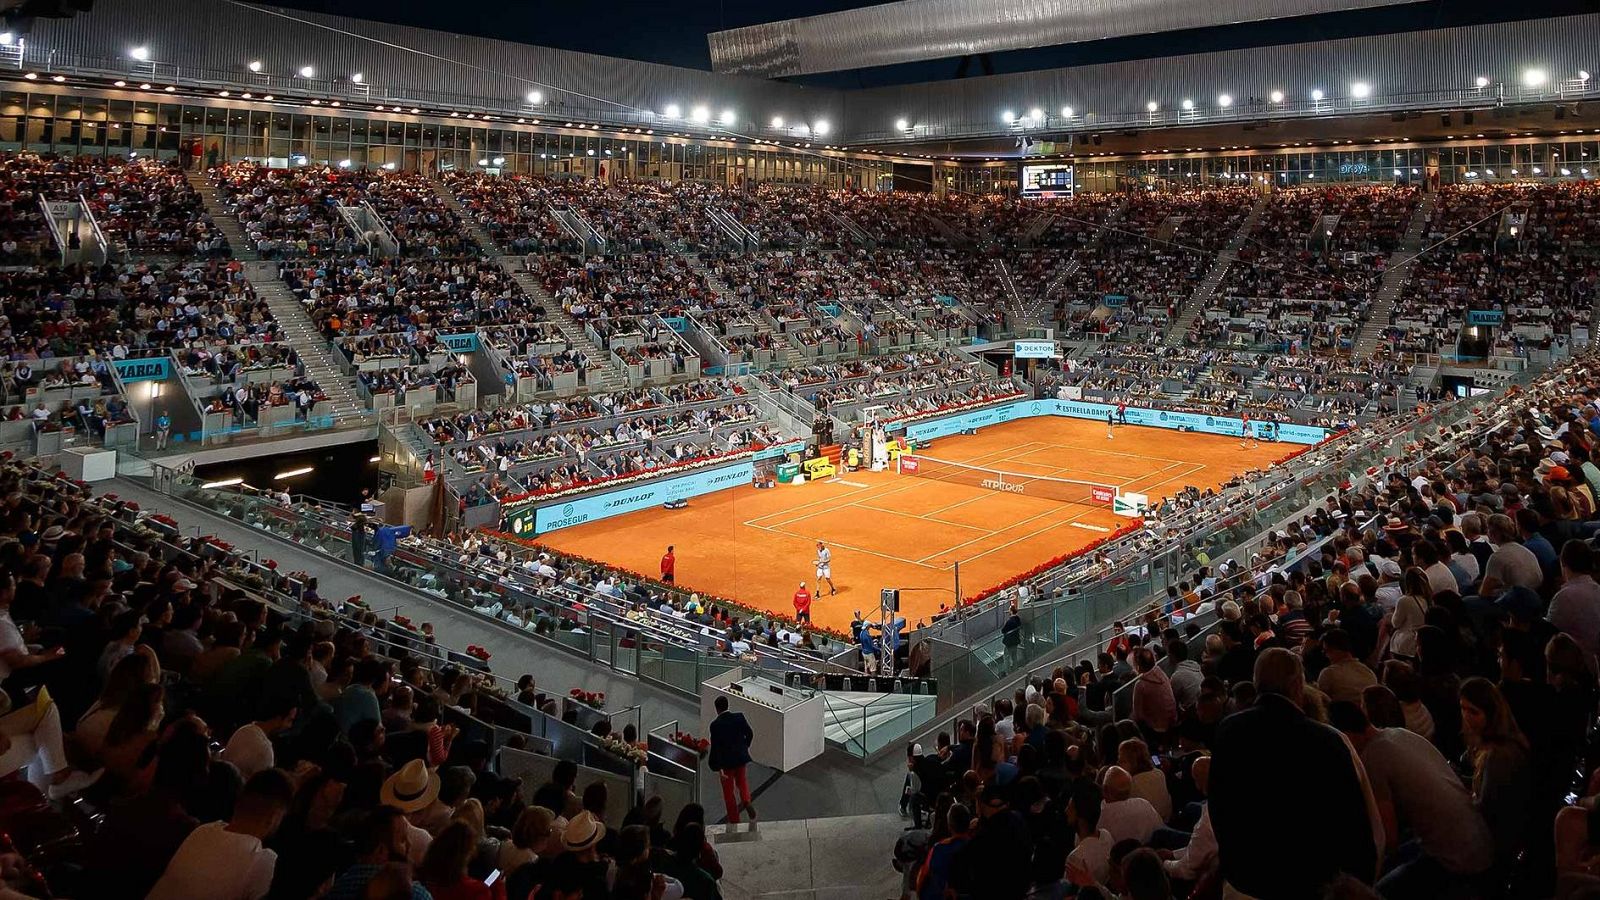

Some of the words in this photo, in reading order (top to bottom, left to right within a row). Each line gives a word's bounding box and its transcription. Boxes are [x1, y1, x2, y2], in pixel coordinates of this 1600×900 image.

[1062, 405, 1091, 415] ESTRELLA
[1278, 430, 1324, 439] adrid-open.com
[714, 470, 749, 484] DUNLOP
[611, 492, 655, 507] DUNLOP
[547, 513, 588, 530] PROSEGUR
